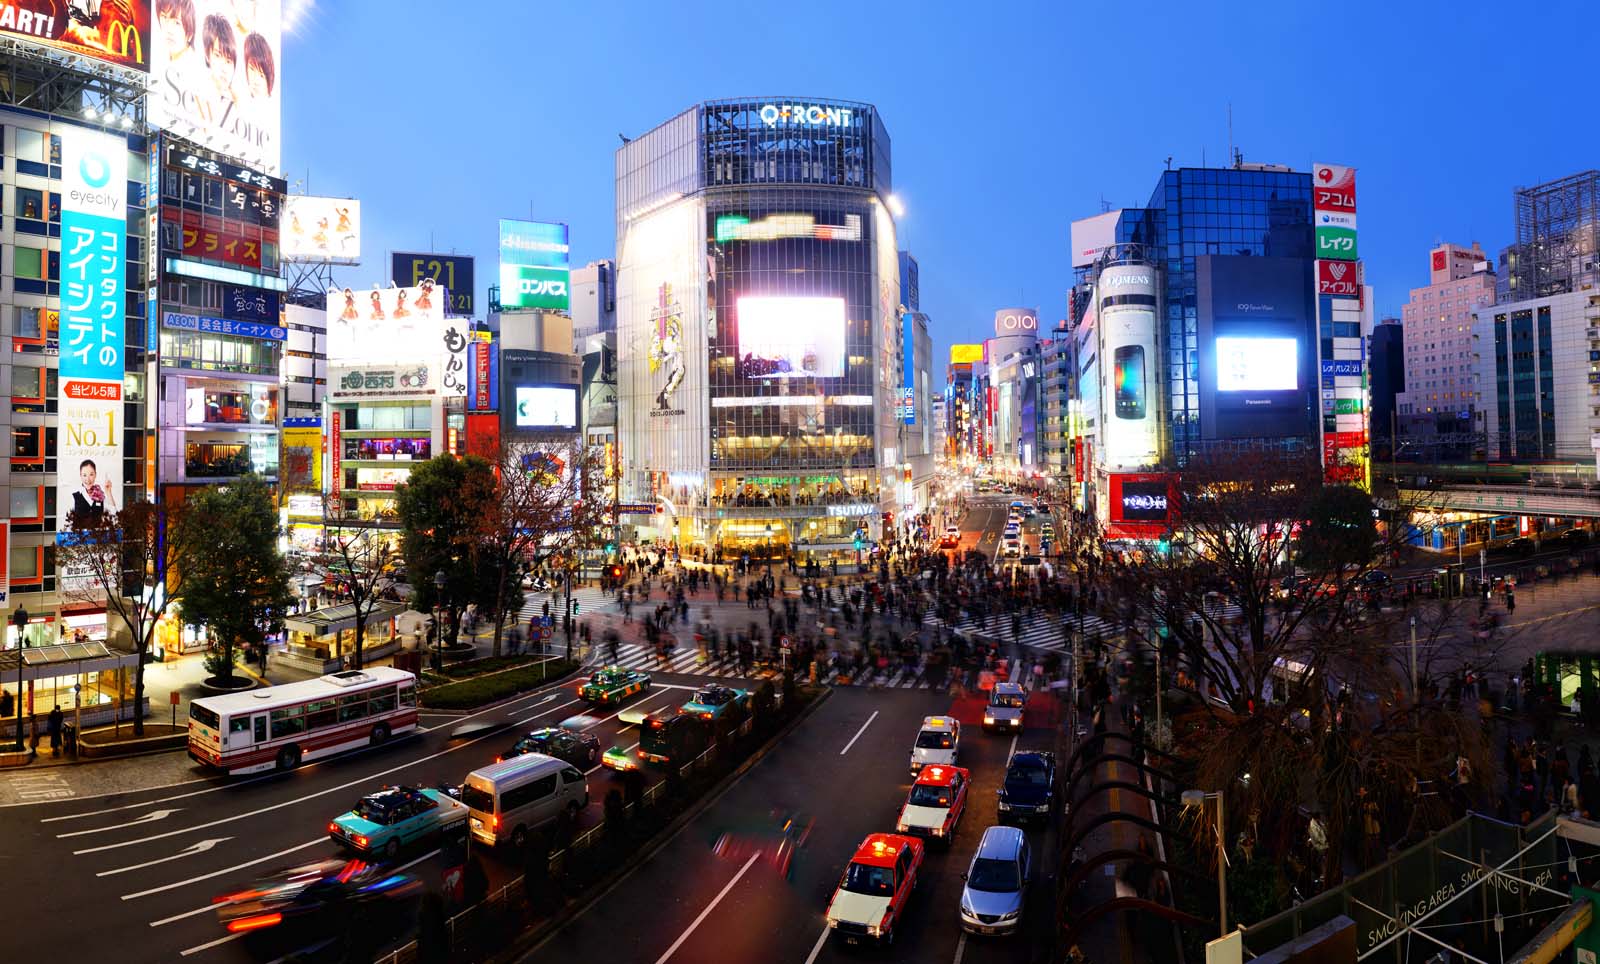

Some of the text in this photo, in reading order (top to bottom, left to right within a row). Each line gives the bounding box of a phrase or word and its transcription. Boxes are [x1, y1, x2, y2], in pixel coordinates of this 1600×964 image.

[0, 4, 55, 38] ART!
[760, 104, 852, 129] QFRONT
[70, 190, 119, 211] eyecity
[1319, 191, 1355, 207] アコム
[182, 230, 258, 259] プライス
[1320, 235, 1354, 251] レイク
[67, 226, 95, 366] アイシティ
[1321, 281, 1356, 294] アイフル
[99, 231, 118, 367] コンタクトの
[167, 314, 196, 327] AEON
[201, 319, 268, 335] 英会話イーオン
[443, 326, 466, 394] もんじゃ
[1322, 364, 1360, 373] レオパレス21
[71, 384, 117, 398] 当ビル5階
[364, 376, 395, 389] 西村
[904, 387, 914, 418] SEIBU
[66, 410, 119, 448] No.1
[829, 504, 876, 517] TSUTAYA
[1429, 882, 1456, 911] AREA
